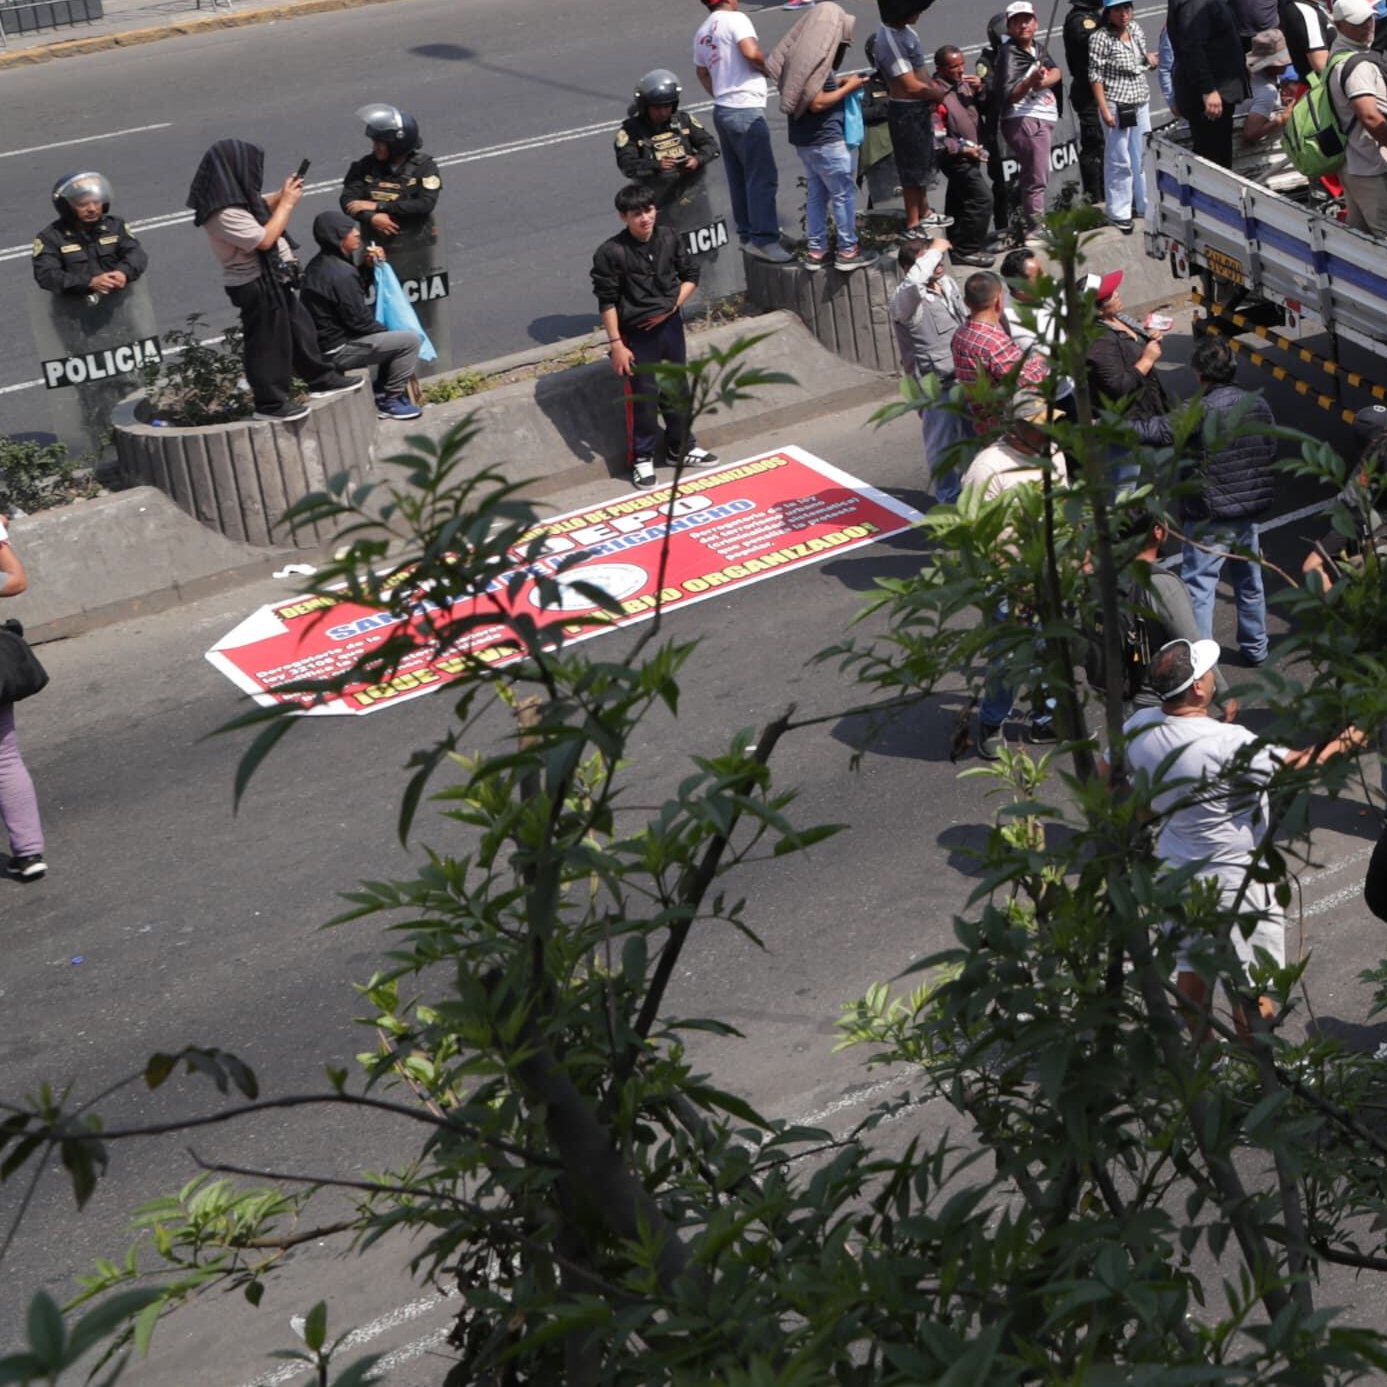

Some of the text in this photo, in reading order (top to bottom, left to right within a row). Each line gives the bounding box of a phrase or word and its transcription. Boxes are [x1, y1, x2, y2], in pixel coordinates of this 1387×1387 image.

[46, 340, 160, 387] POLICIA
[678, 456, 788, 498] ORGANIZADOS
[682, 523, 880, 593] ORGANIZADO!
